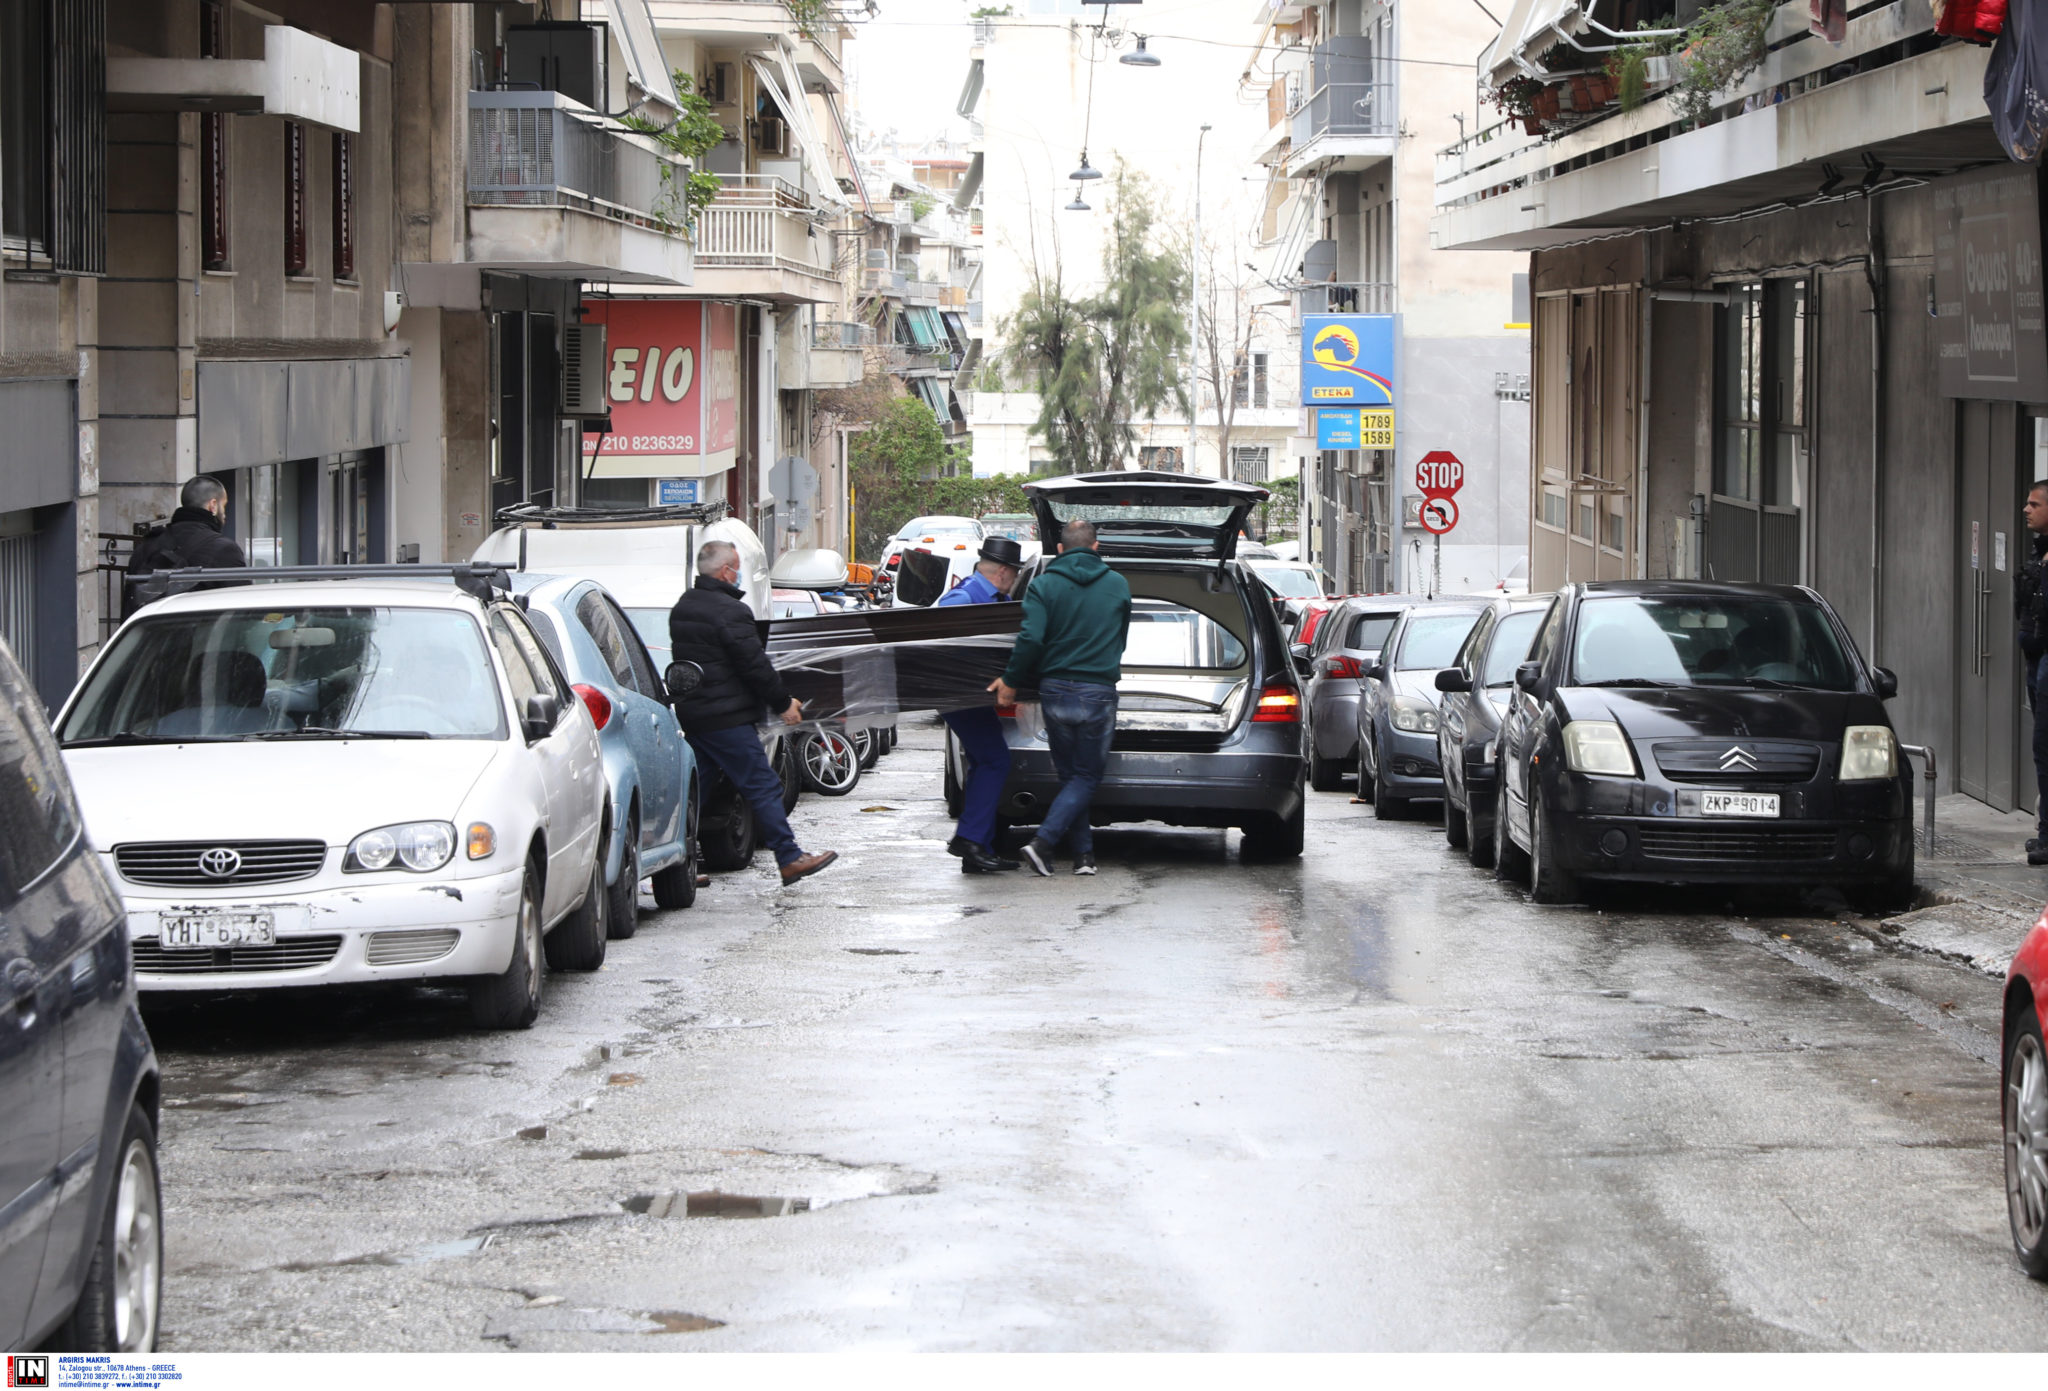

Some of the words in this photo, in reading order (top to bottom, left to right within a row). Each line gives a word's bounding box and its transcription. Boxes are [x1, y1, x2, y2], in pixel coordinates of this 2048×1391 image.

[1363, 415, 1391, 429] 1789
[602, 435, 628, 451] 210
[632, 435, 694, 451] 8236329
[1363, 431, 1391, 444] 1589
[1417, 461, 1463, 489] STOP
